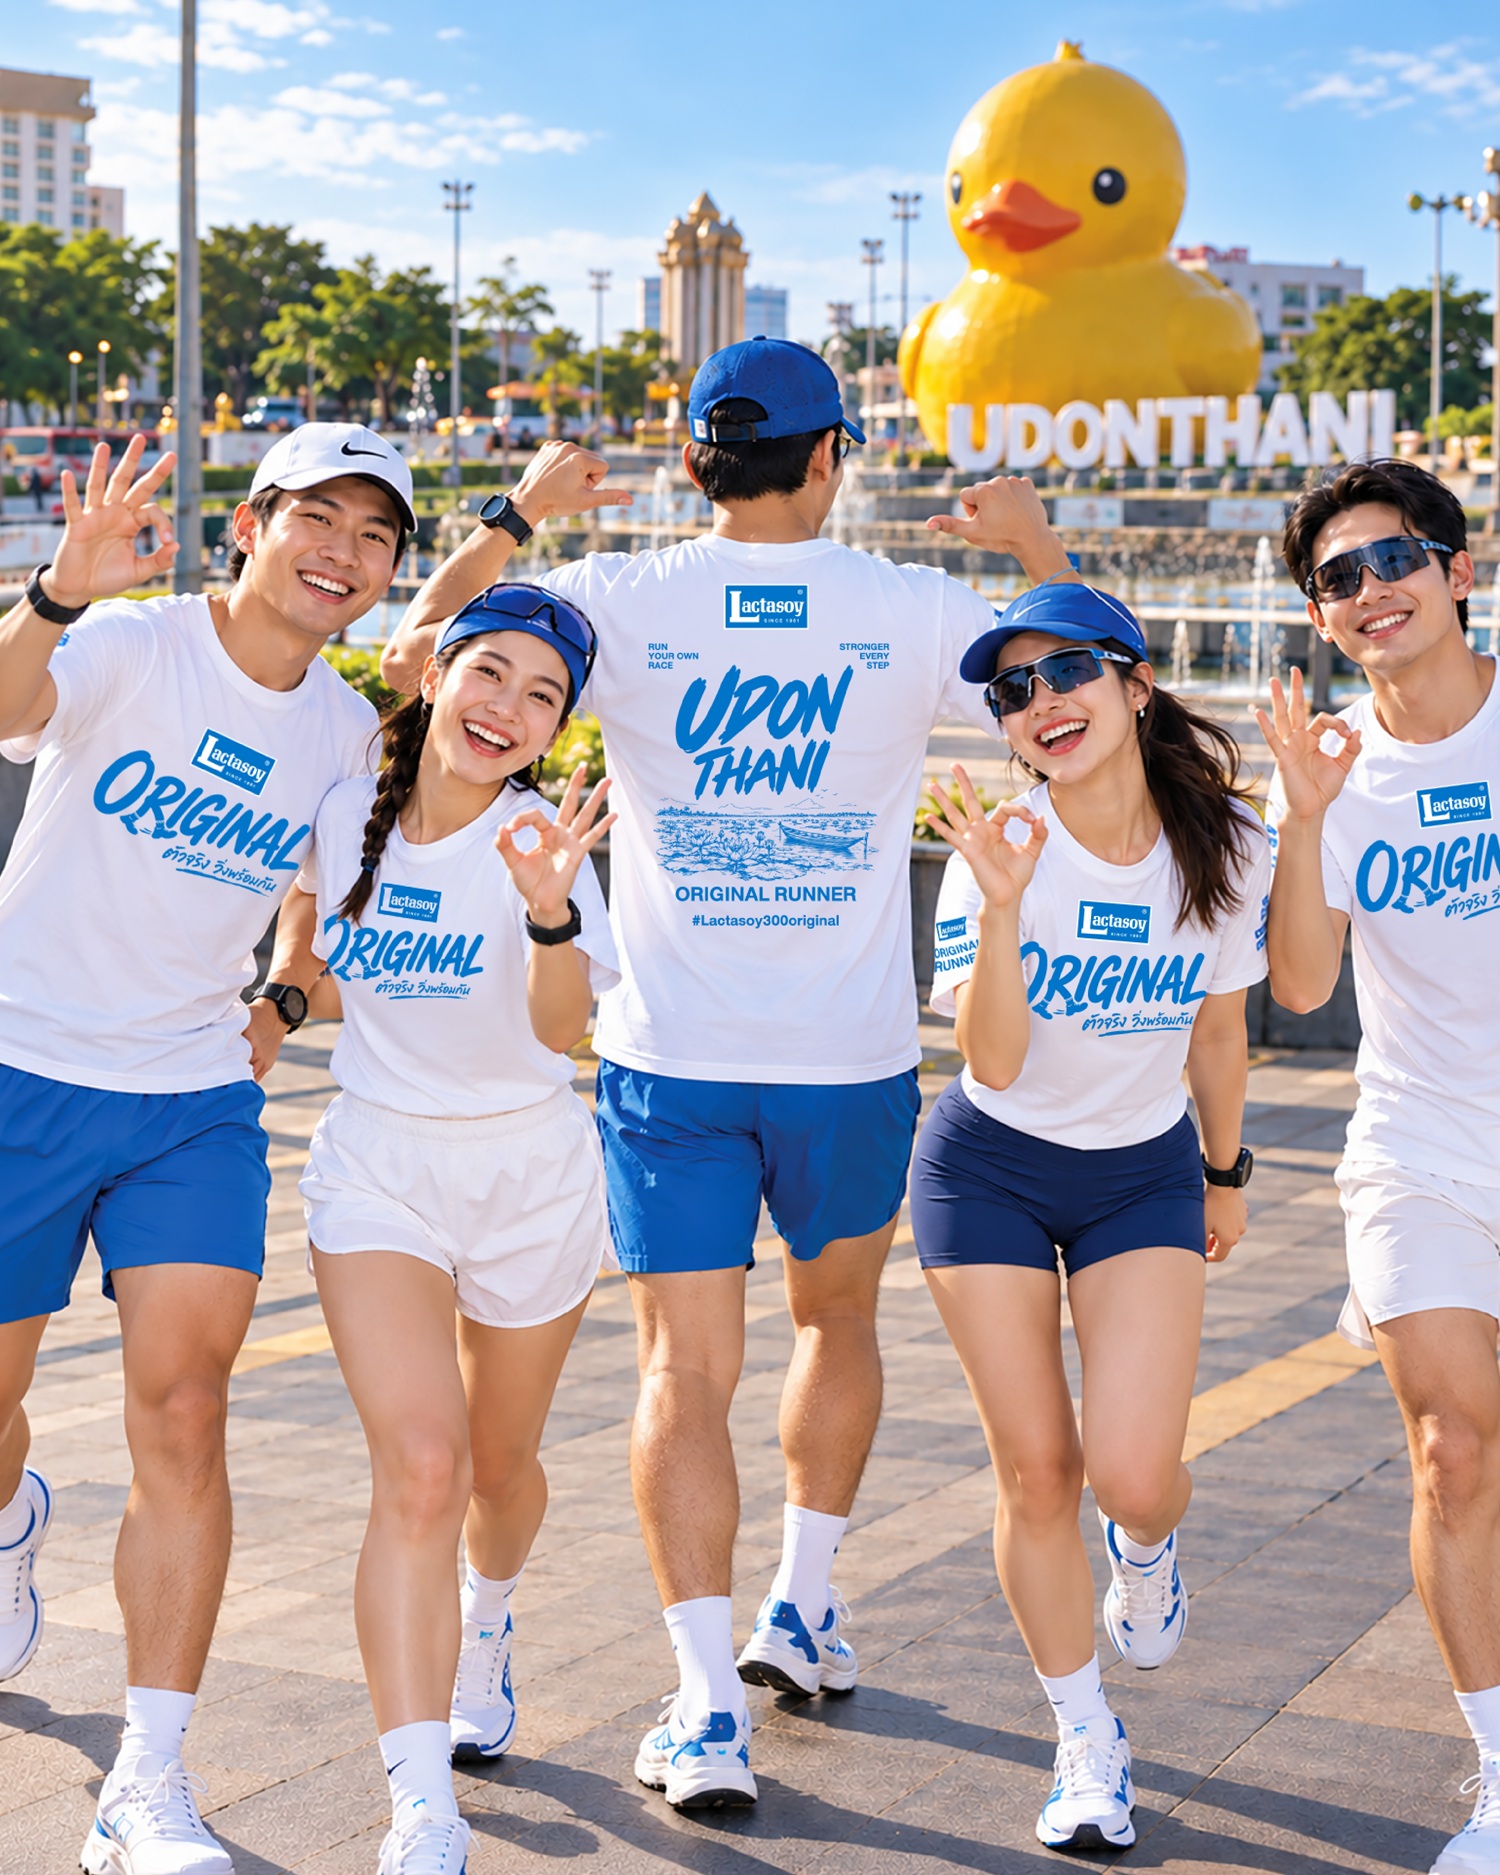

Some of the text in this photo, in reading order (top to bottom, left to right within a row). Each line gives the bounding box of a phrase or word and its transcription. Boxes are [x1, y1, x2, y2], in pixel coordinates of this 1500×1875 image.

[729, 590, 805, 623] Lactasoy
[648, 643, 668, 651] RUN
[648, 652, 699, 660] YOUR OWN
[839, 643, 890, 651] STRONGER
[859, 652, 889, 660] EVERY
[648, 662, 673, 670] RACE
[866, 661, 890, 670] STEP
[675, 664, 854, 754] UDON
[196, 734, 267, 783] Lactasoy
[693, 739, 831, 801] THANI
[93, 750, 311, 871] ORIGINAL
[1420, 793, 1487, 822] Lactasoy
[380, 886, 438, 914] Lactasoy
[675, 886, 857, 903] ORIGINAL RUNNER
[691, 914, 840, 929] #Lactasoy300original
[1080, 905, 1148, 936] Lactasoy
[324, 913, 485, 982] ORIGINAL
[934, 952, 976, 972] RUNNE
[1020, 941, 1206, 1020] ORIGINAL
